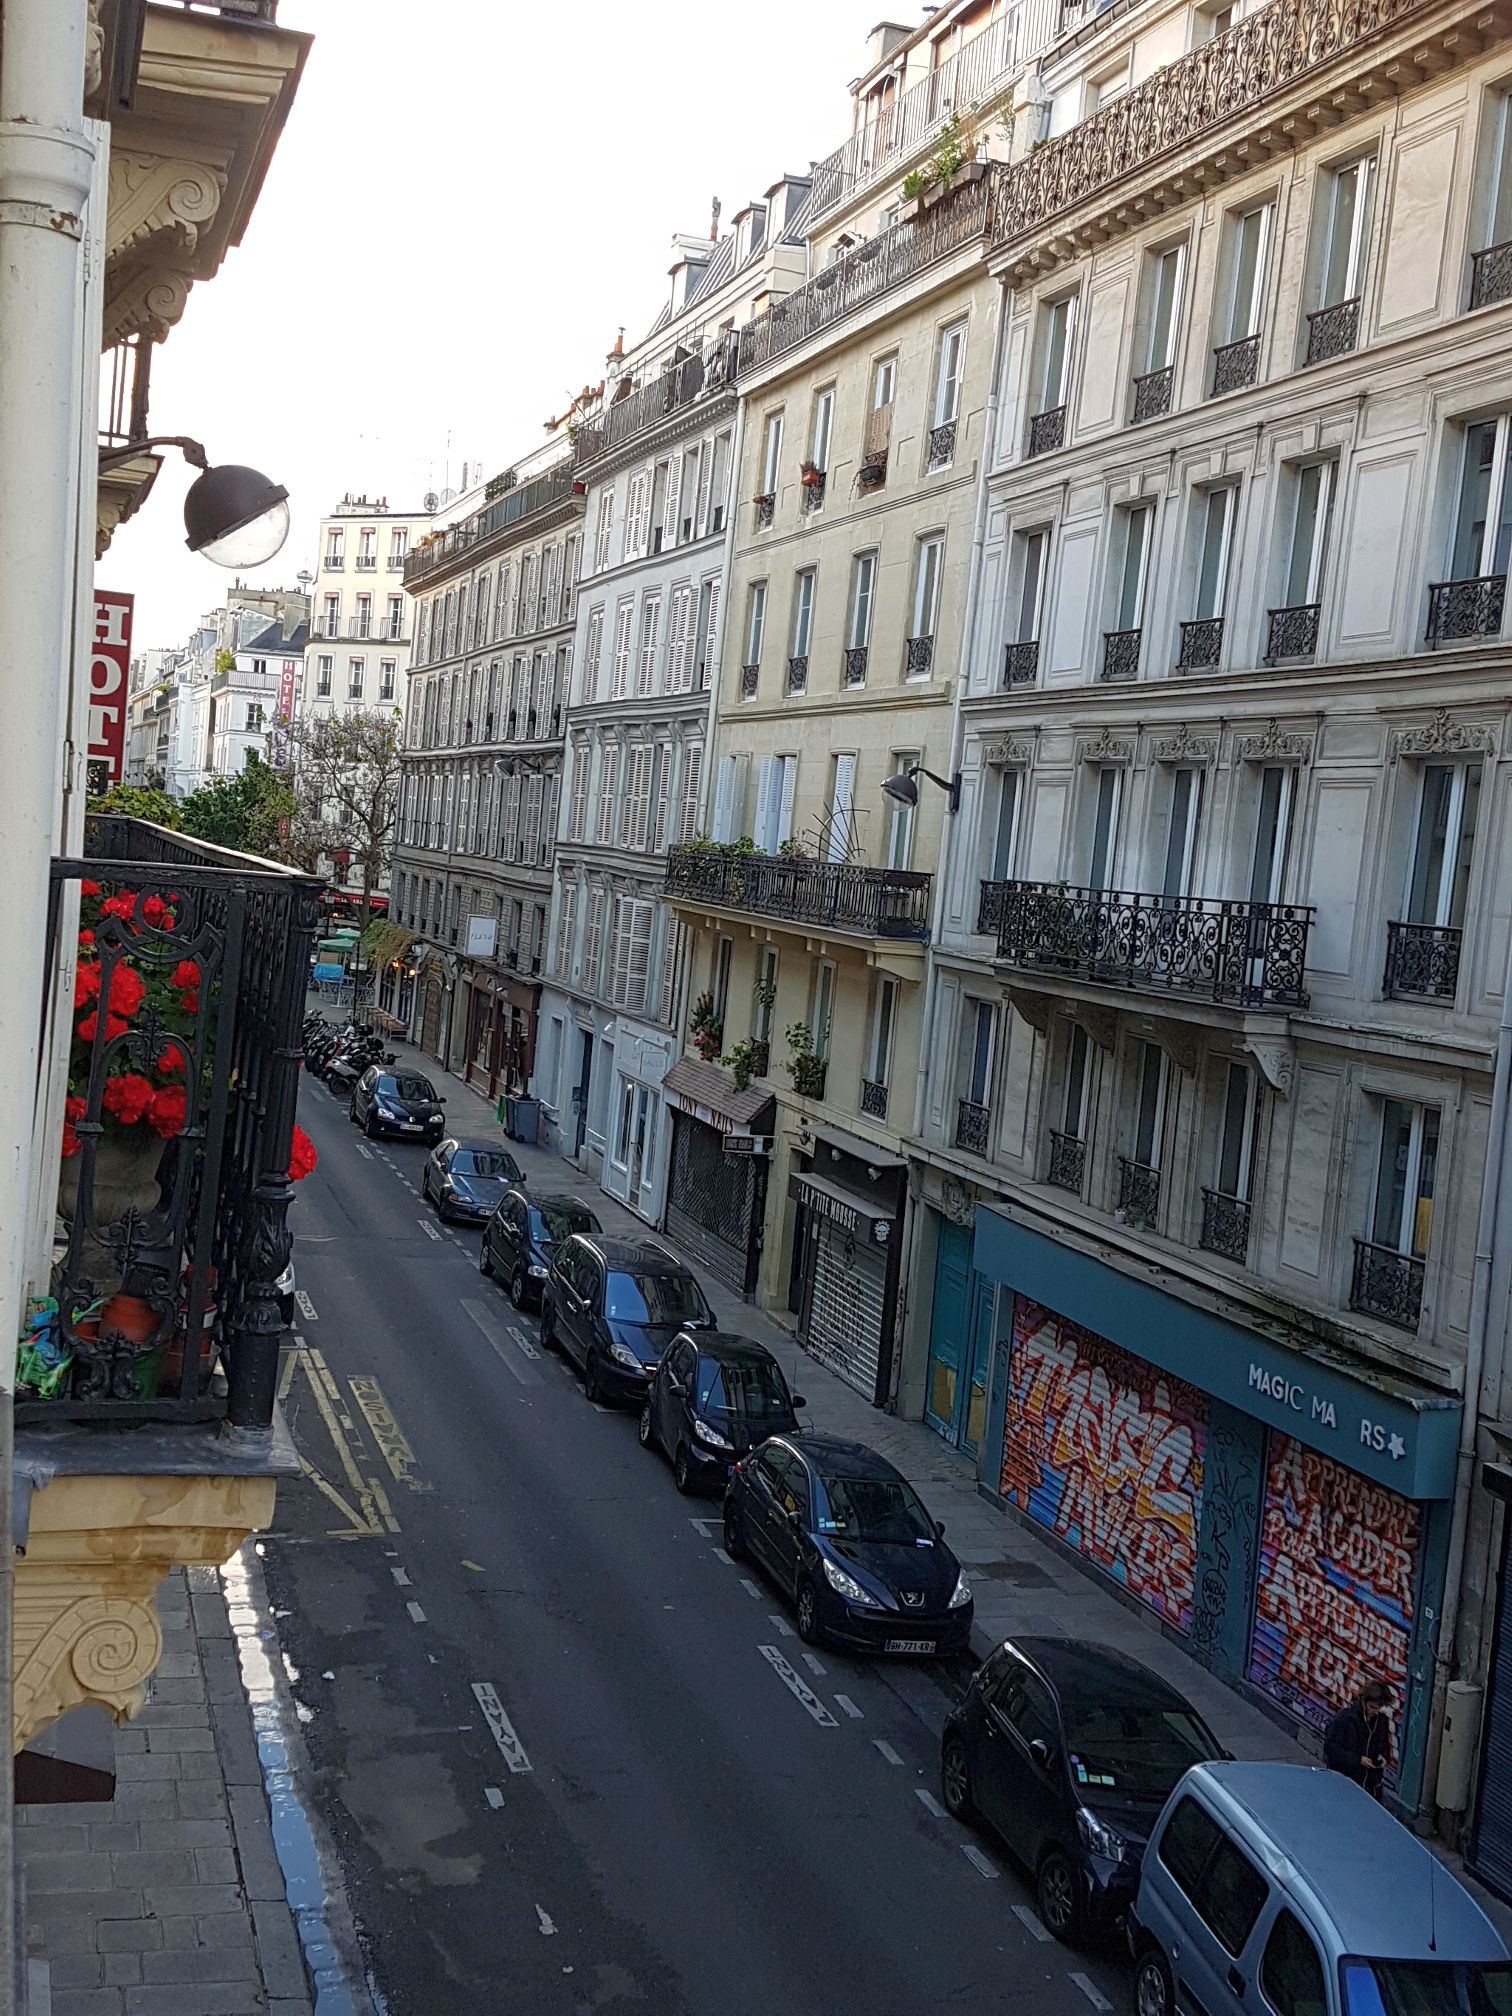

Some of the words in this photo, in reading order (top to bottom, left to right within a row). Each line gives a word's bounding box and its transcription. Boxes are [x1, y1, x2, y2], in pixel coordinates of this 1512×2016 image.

[710, 1109, 733, 1135] NAILS
[830, 1200, 857, 1231] MOUSSE
[1249, 1363, 1304, 1410] MAGIC
[1270, 1437, 1420, 1546] APPRENDRE
[1265, 1509, 1326, 1574] POUR
[1330, 1512, 1414, 1616] CODER
[1262, 1553, 1408, 1674] APPRENDRE
[765, 1647, 835, 1724] PAYANT
[478, 1685, 530, 1769] PAYANT
